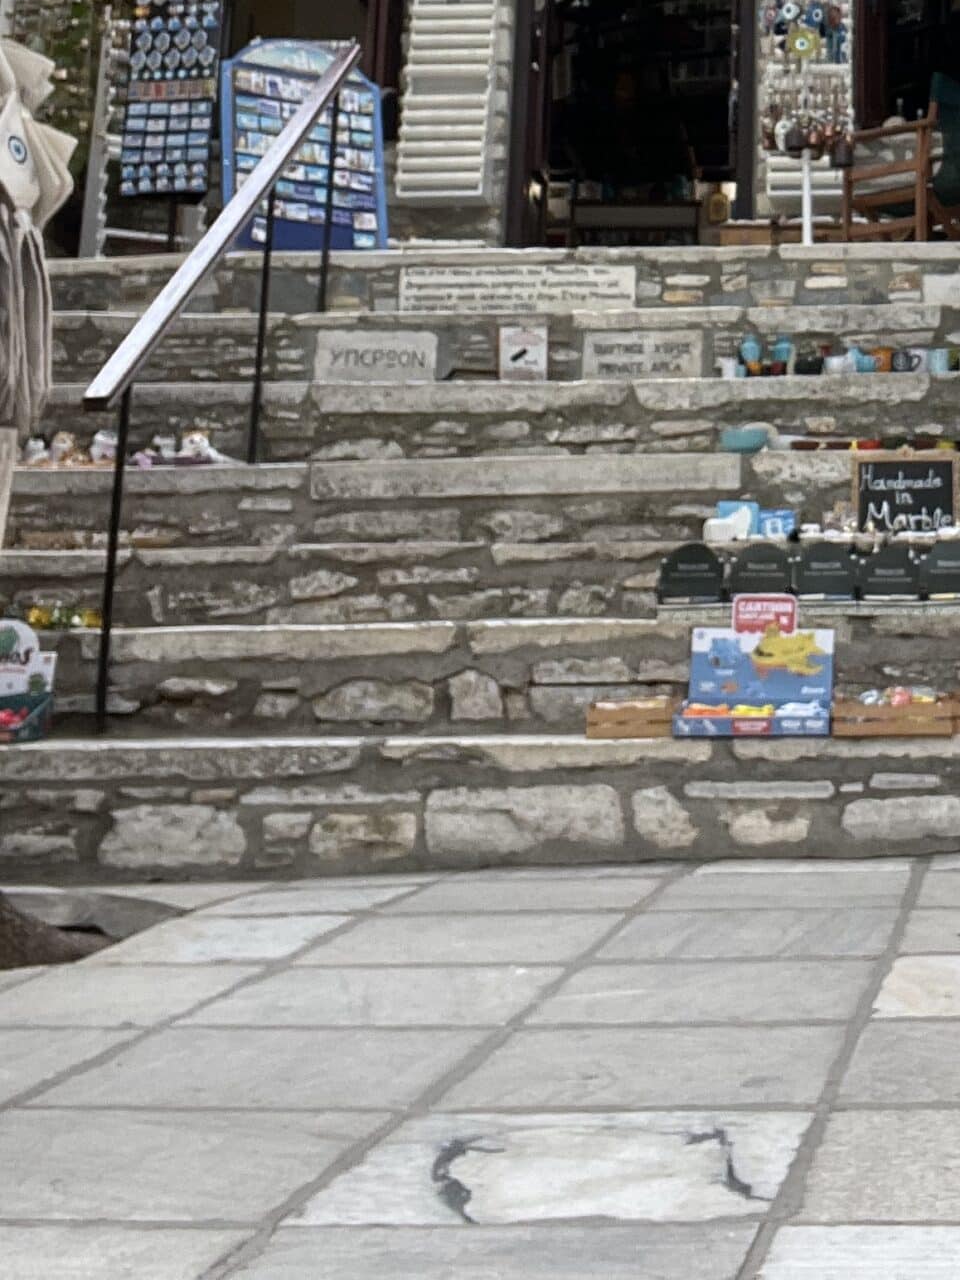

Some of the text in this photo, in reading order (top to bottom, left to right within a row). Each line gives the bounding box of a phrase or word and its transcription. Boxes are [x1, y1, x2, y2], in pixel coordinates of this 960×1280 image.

[860, 464, 943, 491] Handmade
[895, 491, 914, 505] in
[864, 500, 952, 531] Marble
